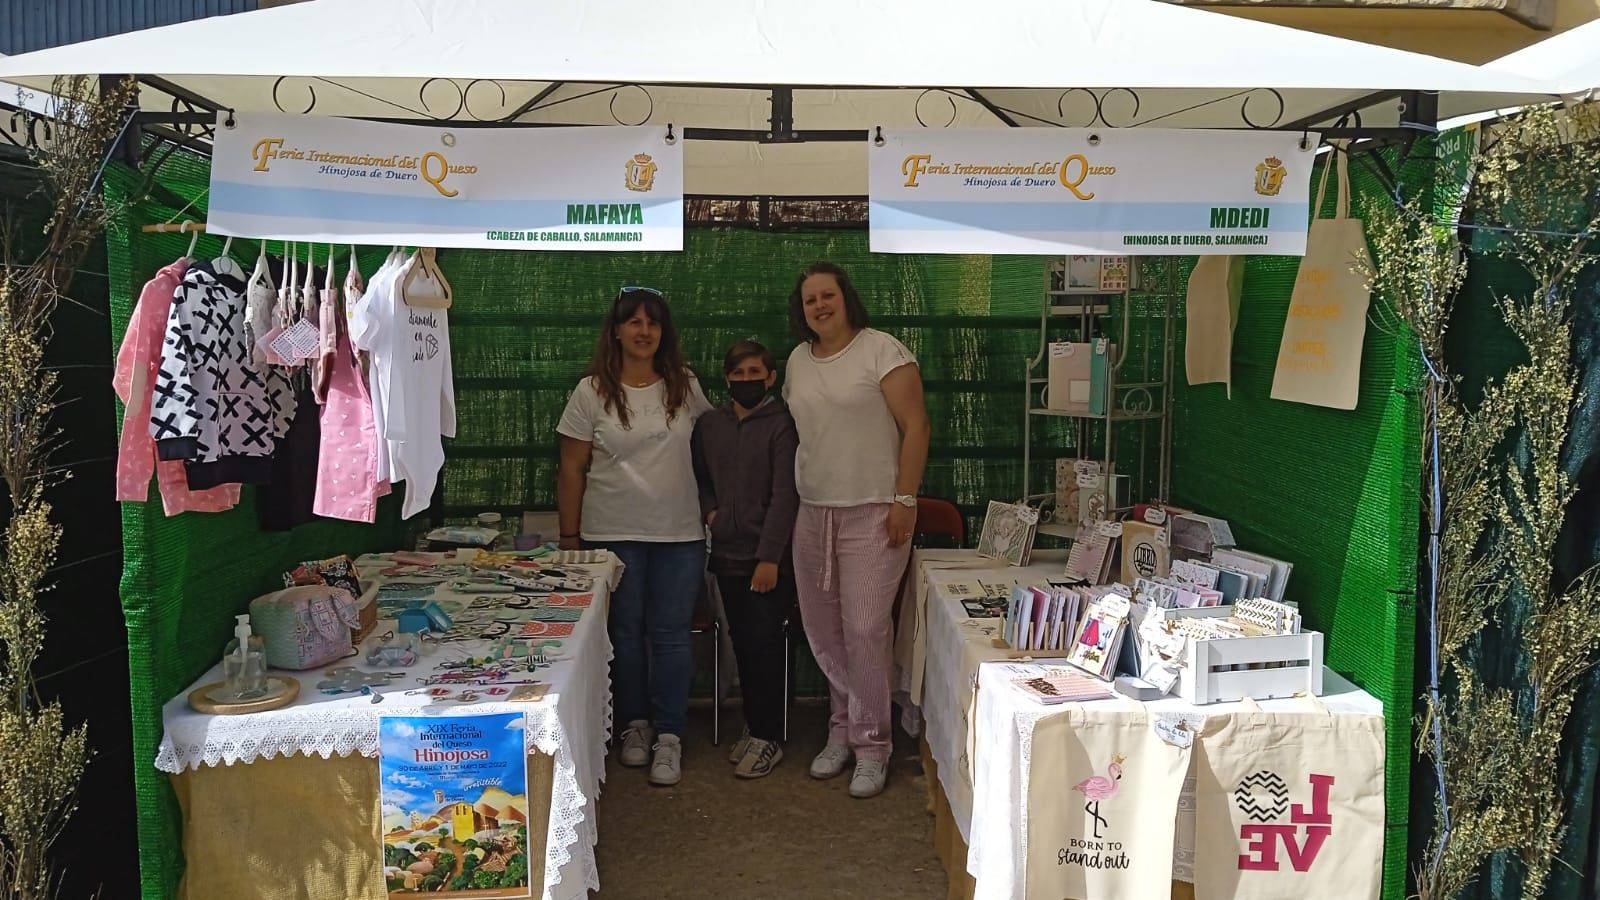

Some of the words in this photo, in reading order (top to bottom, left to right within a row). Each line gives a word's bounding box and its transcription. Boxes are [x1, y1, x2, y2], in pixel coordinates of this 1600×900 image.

[252, 138, 304, 172] Feria
[305, 150, 397, 169] Internacional
[399, 156, 418, 169] del
[421, 151, 477, 198] Queso
[318, 165, 366, 179] Hinojosa
[370, 168, 382, 178] de
[385, 170, 418, 181] Duero
[902, 154, 950, 188] Feria
[952, 162, 1035, 175] Internacional
[1037, 162, 1060, 175] del
[1060, 154, 1116, 200] Queso
[963, 176, 1007, 189] Hinojosa
[1010, 177, 1022, 187] de
[1024, 178, 1056, 187] Duero
[567, 203, 643, 225] MAFAYA
[1210, 207, 1270, 229] MDEDI
[487, 230, 525, 241] (CABEZA
[527, 231, 539, 241] DE
[540, 231, 582, 242] CABALLO,
[584, 231, 642, 242] SALAMANCA)
[1123, 235, 1169, 246] (HINOJOSA
[1171, 235, 1182, 245] DE
[1183, 235, 1214, 246] DUERO,
[1215, 235, 1268, 246] SALAMANCA)
[420, 730, 482, 741] Internacional
[427, 724, 448, 734] XIX
[451, 723, 476, 733] Feria
[432, 741, 444, 749] del
[445, 740, 473, 749] Queso
[414, 748, 489, 764] Hinojosa
[1070, 838, 1104, 851] BORN
[1107, 842, 1122, 851] TO
[1104, 851, 1130, 869] out
